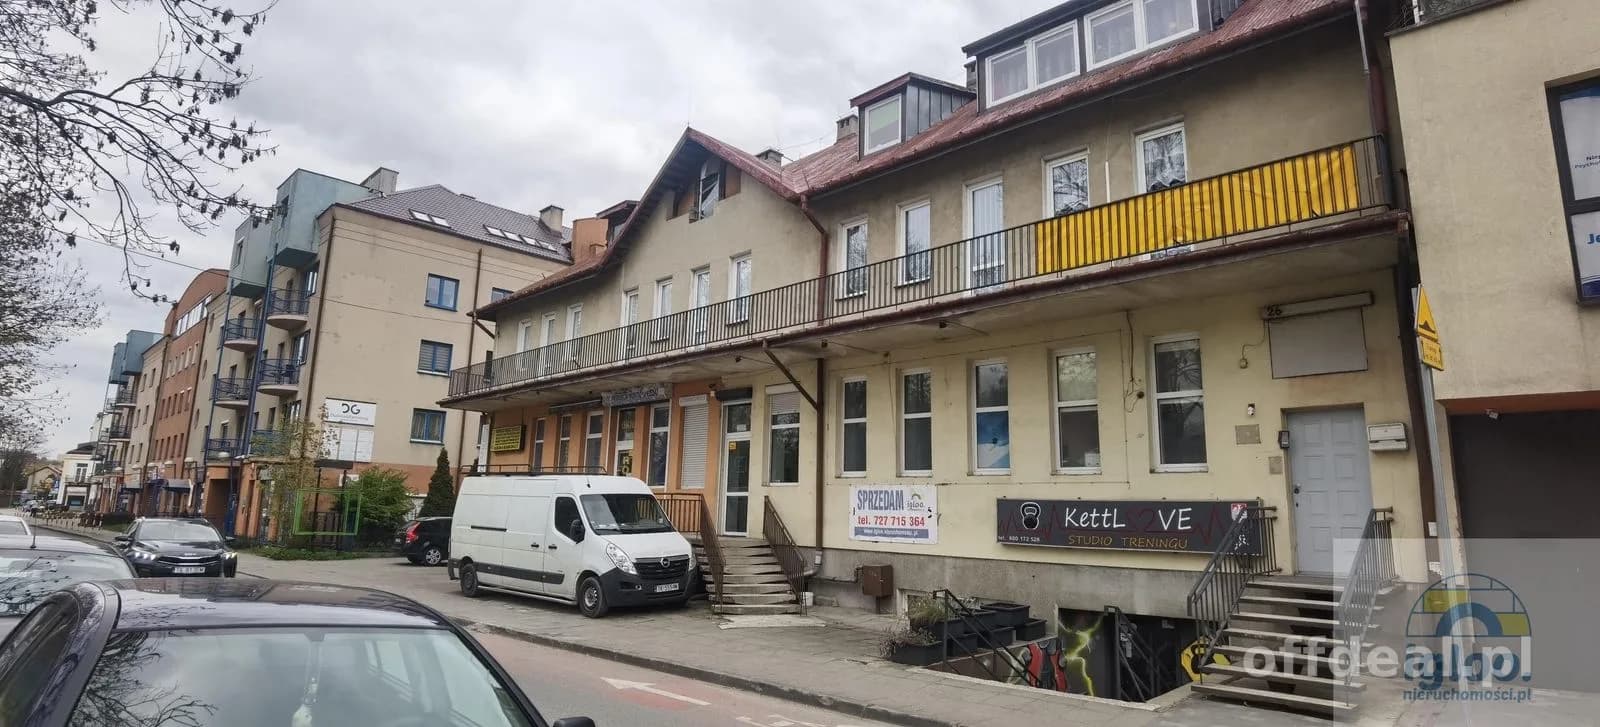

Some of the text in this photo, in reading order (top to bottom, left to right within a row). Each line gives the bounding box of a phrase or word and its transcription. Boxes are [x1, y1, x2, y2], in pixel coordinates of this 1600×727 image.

[1266, 305, 1282, 316] 26
[857, 489, 904, 511] SPRZEDAM
[858, 515, 925, 526] tel. 727 715 364
[1068, 534, 1188, 549] STUDIO TRENINGU
